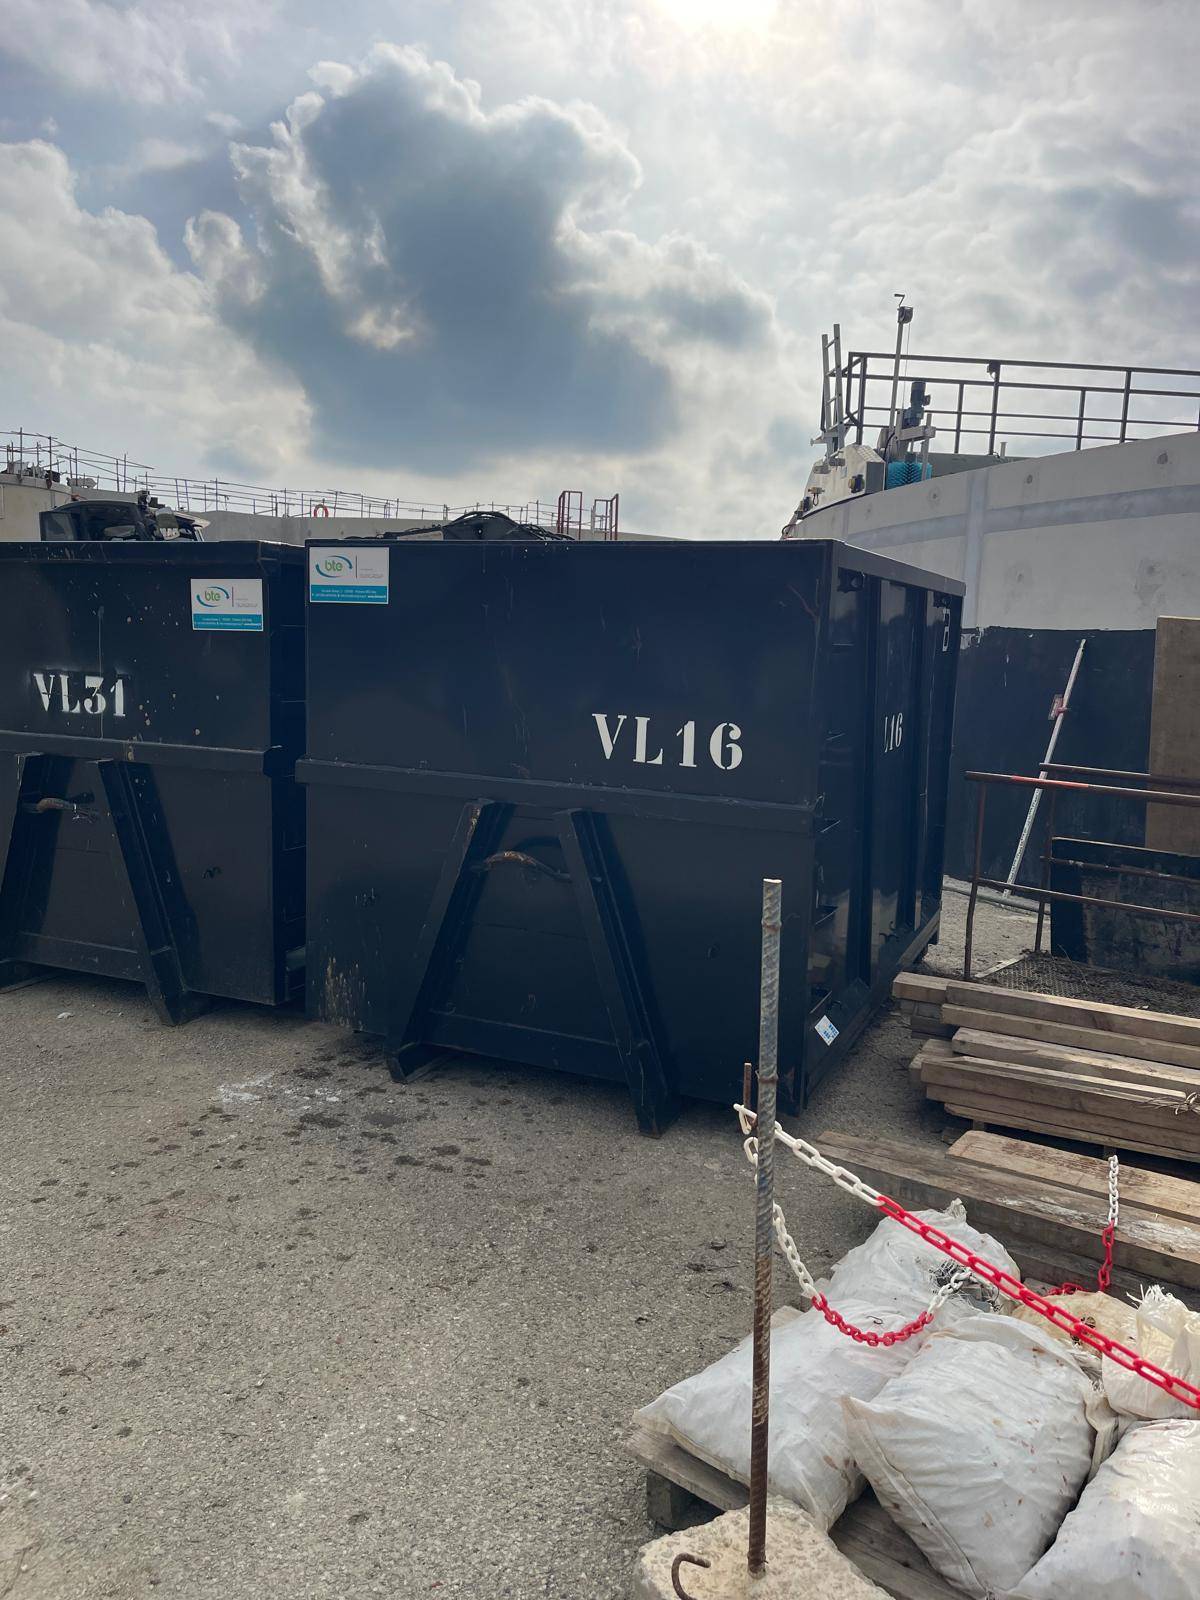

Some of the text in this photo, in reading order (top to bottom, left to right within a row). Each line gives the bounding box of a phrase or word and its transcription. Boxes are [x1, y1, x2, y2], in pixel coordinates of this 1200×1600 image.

[324, 560, 343, 571] bte
[205, 591, 221, 601] bte
[33, 673, 126, 717] VL31
[592, 713, 743, 770] VL16
